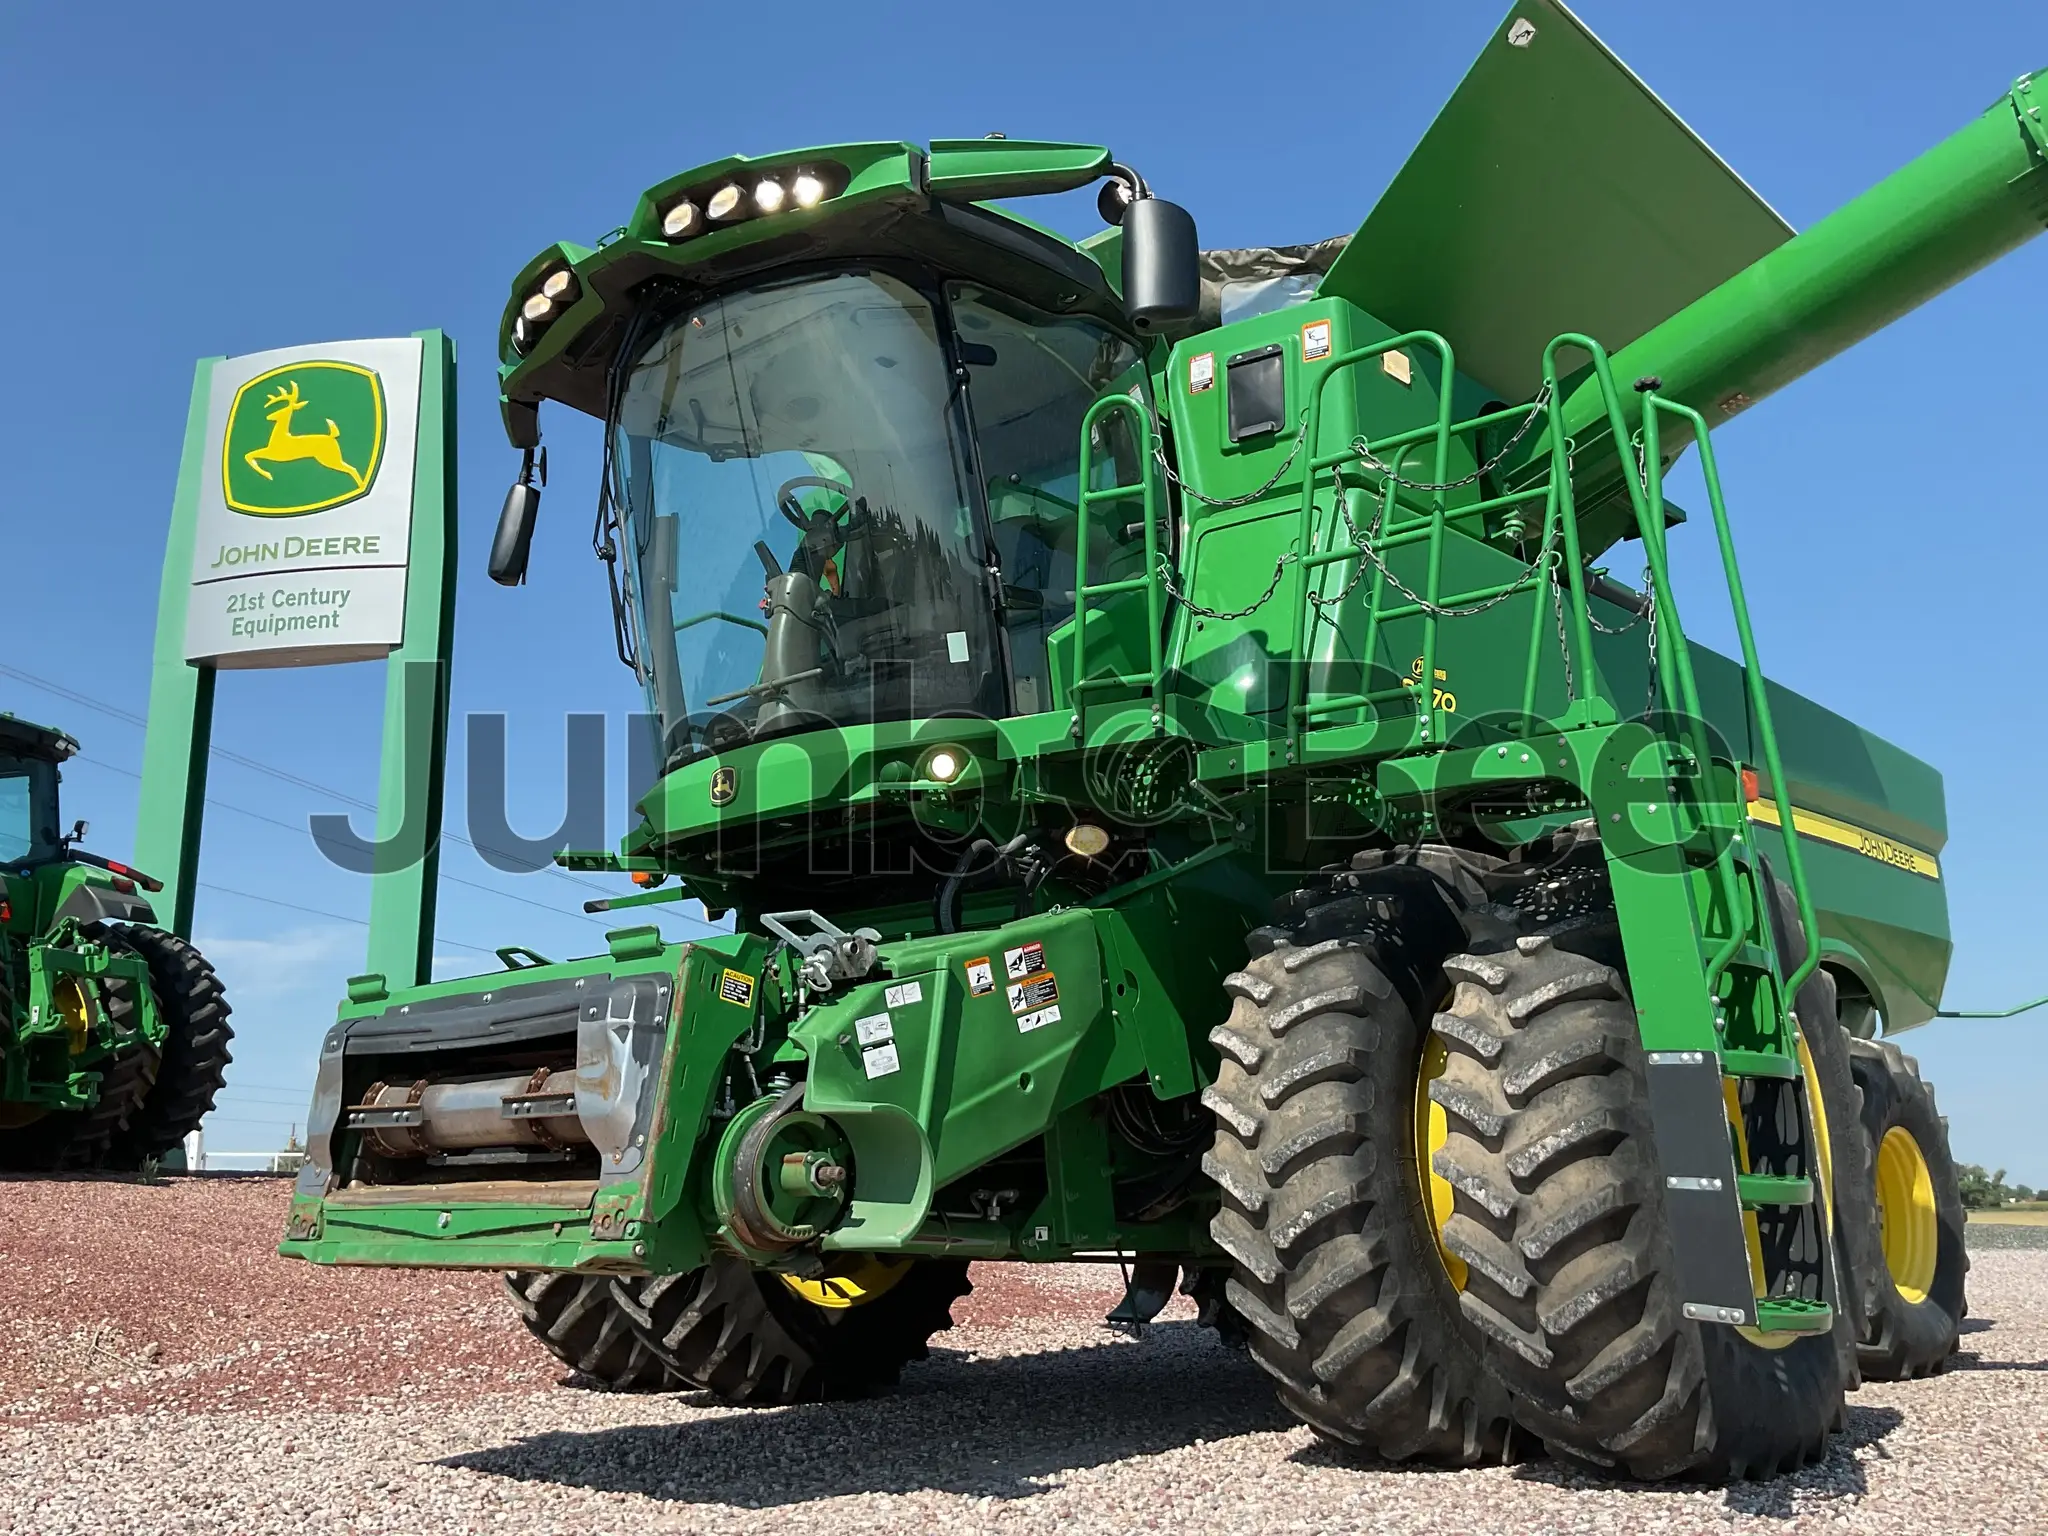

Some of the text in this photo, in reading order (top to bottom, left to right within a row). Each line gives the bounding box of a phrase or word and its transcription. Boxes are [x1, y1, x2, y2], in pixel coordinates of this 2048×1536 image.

[211, 536, 380, 568] JOHN DEERE
[226, 588, 350, 613] 21st Century
[232, 610, 339, 638] Equipment
[1859, 832, 1916, 870] JOHN DEERE
[729, 971, 753, 984] CAUTION
